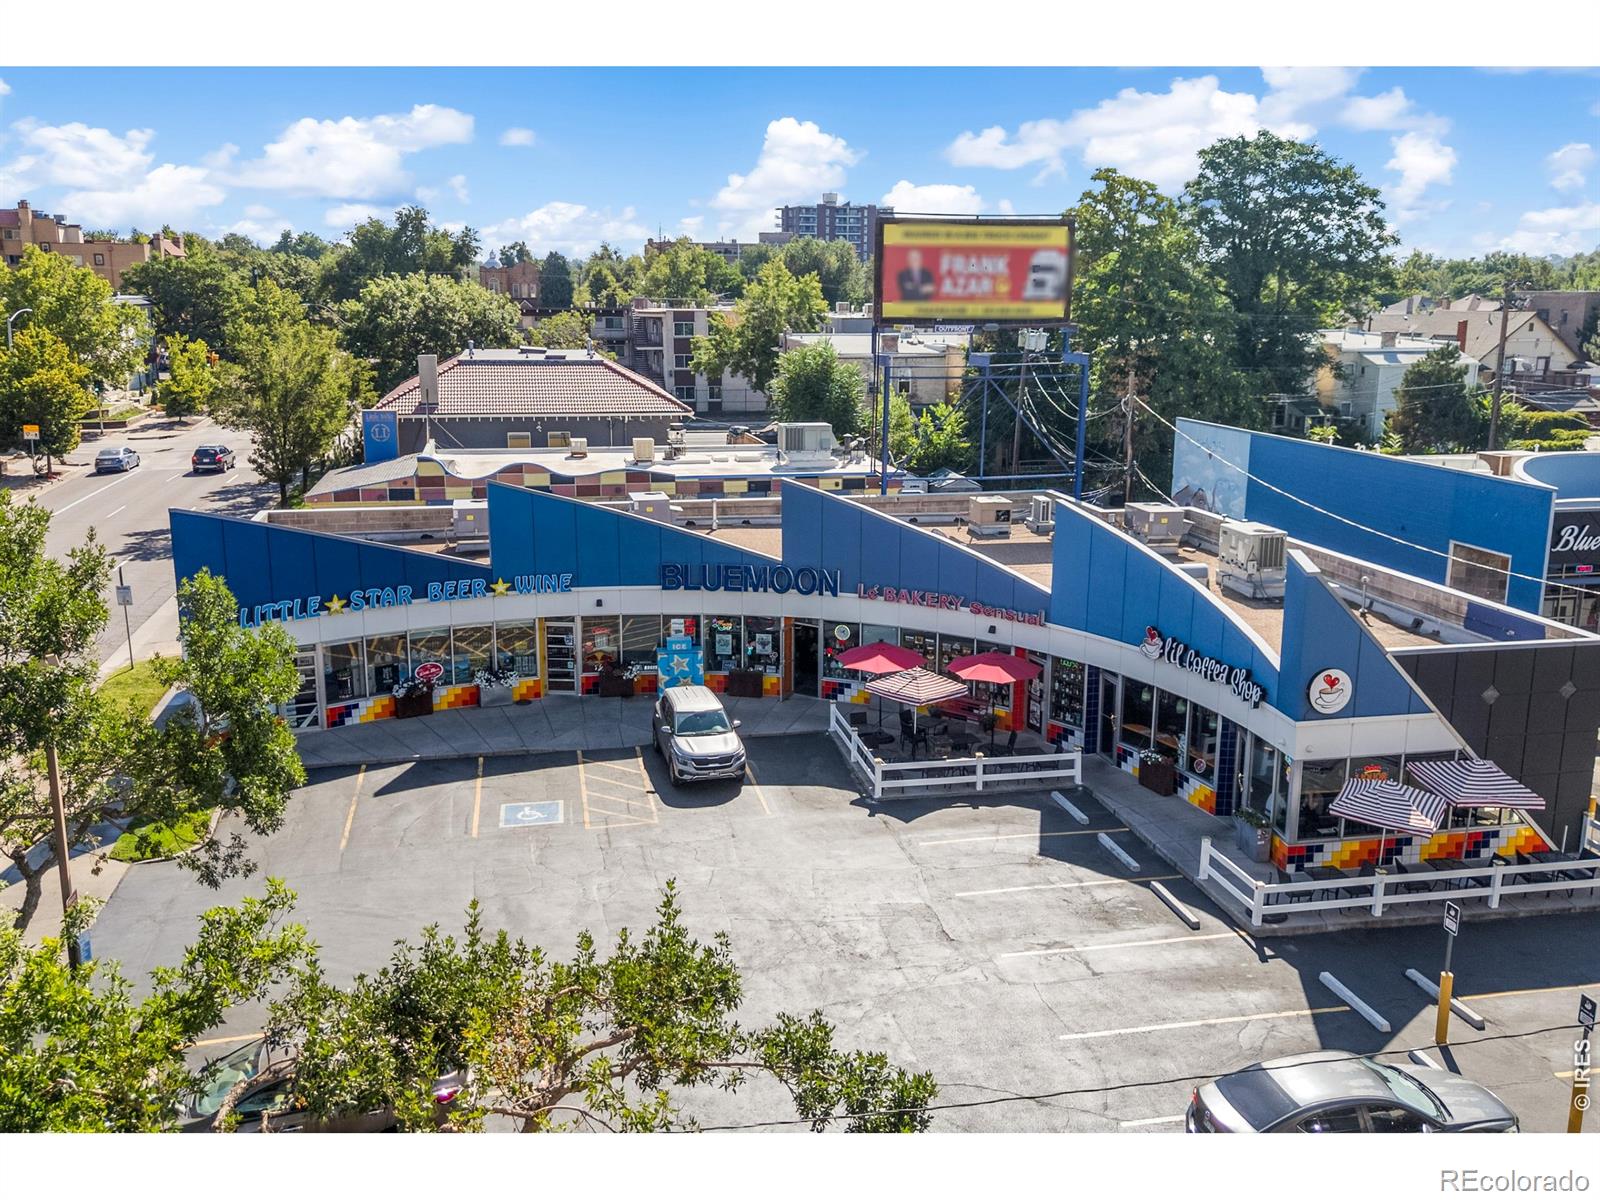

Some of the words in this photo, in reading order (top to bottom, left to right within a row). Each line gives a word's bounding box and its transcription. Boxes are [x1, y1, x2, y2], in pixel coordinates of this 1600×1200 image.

[939, 254, 1010, 274] FRANK
[941, 276, 994, 296] AZAR
[1551, 524, 1600, 552] Blue
[661, 563, 841, 598] BLUEMOON
[239, 596, 321, 629] LITTLE
[350, 585, 413, 612] STAR
[427, 578, 487, 603] BEER
[514, 573, 573, 595] WINE
[883, 586, 965, 611] BAKERY
[969, 601, 1047, 627] Sensual
[1230, 668, 1262, 709] Shop
